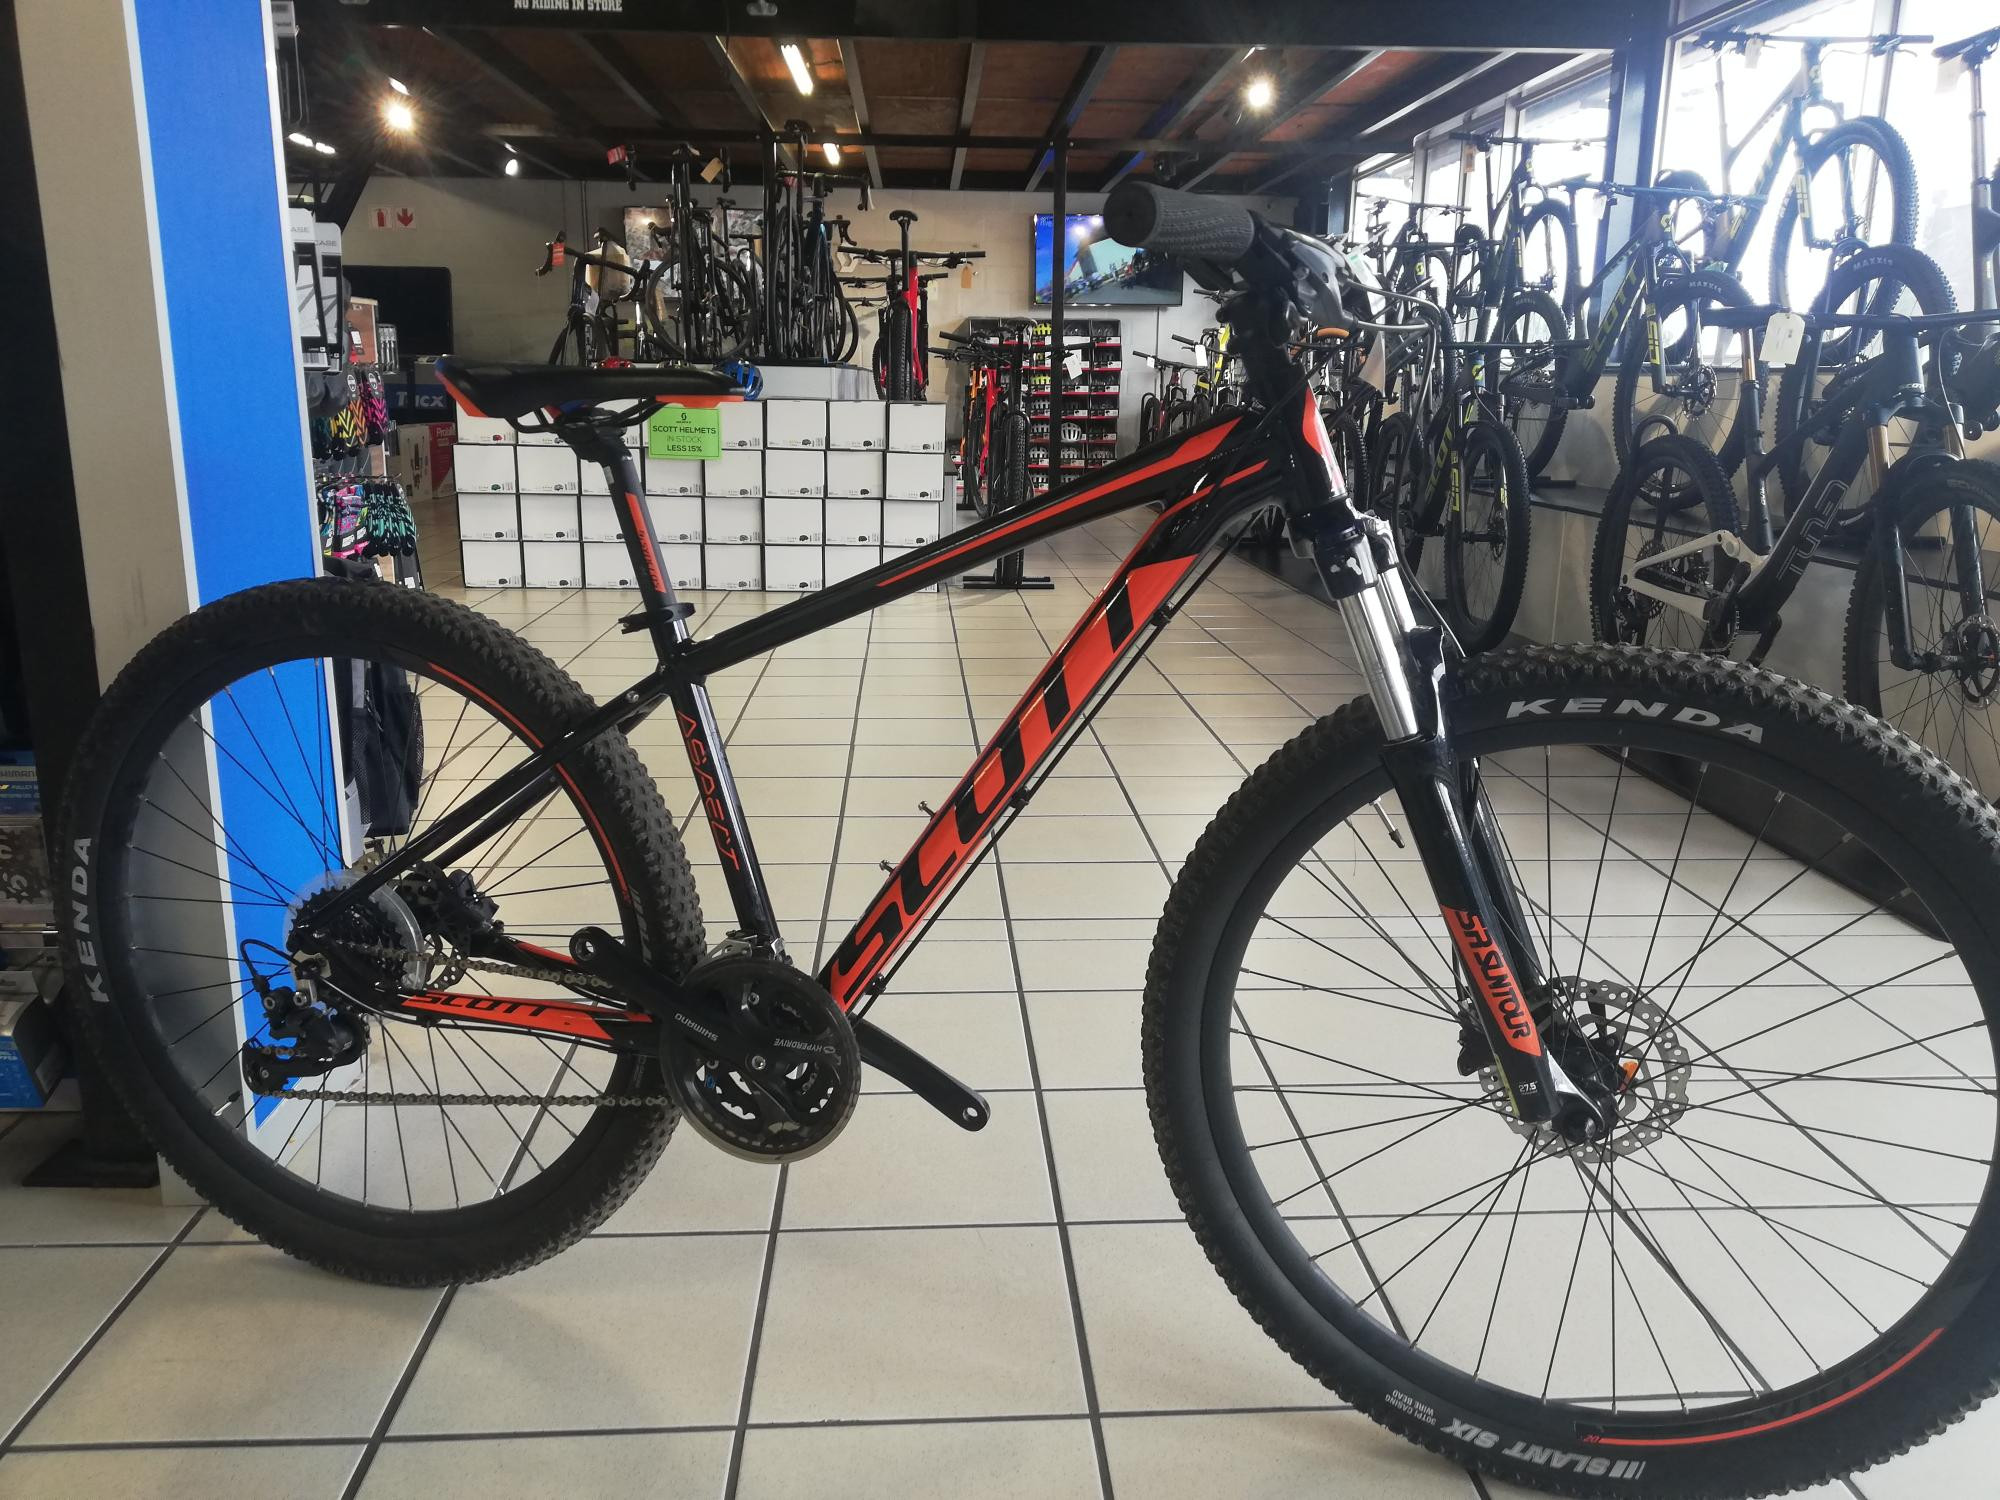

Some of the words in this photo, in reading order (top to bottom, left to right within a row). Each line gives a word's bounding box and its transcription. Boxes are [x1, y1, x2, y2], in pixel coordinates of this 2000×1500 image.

[514, 0, 529, 9] NO
[531, 0, 570, 10] RIDING
[572, 0, 584, 11] IN
[587, 0, 622, 12] STORE
[652, 425, 678, 433] SCOTT
[679, 426, 717, 435] HELMETS
[666, 435, 675, 443] IN
[676, 435, 702, 443] STOCK
[666, 444, 687, 452] LESS
[688, 445, 703, 453] 15%
[1506, 697, 1764, 745] KENDA
[676, 709, 740, 872] ASPECT
[824, 562, 1136, 1006] SCOTT
[70, 837, 111, 1003] KENDA
[1456, 910, 1493, 949] SR
[408, 991, 552, 1018] SCOTT
[1474, 950, 1532, 1040] SUNTOUR
[674, 1011, 719, 1043] SHIMANO
[773, 1037, 823, 1053] HYPERDRIVE
[1384, 1393, 1414, 1415] CASING
[1392, 1388, 1413, 1406] BEAD
[1413, 1400, 1435, 1418] WIRE
[1440, 1417, 1500, 1449] SIX
[1501, 1440, 1611, 1476] SLANT
